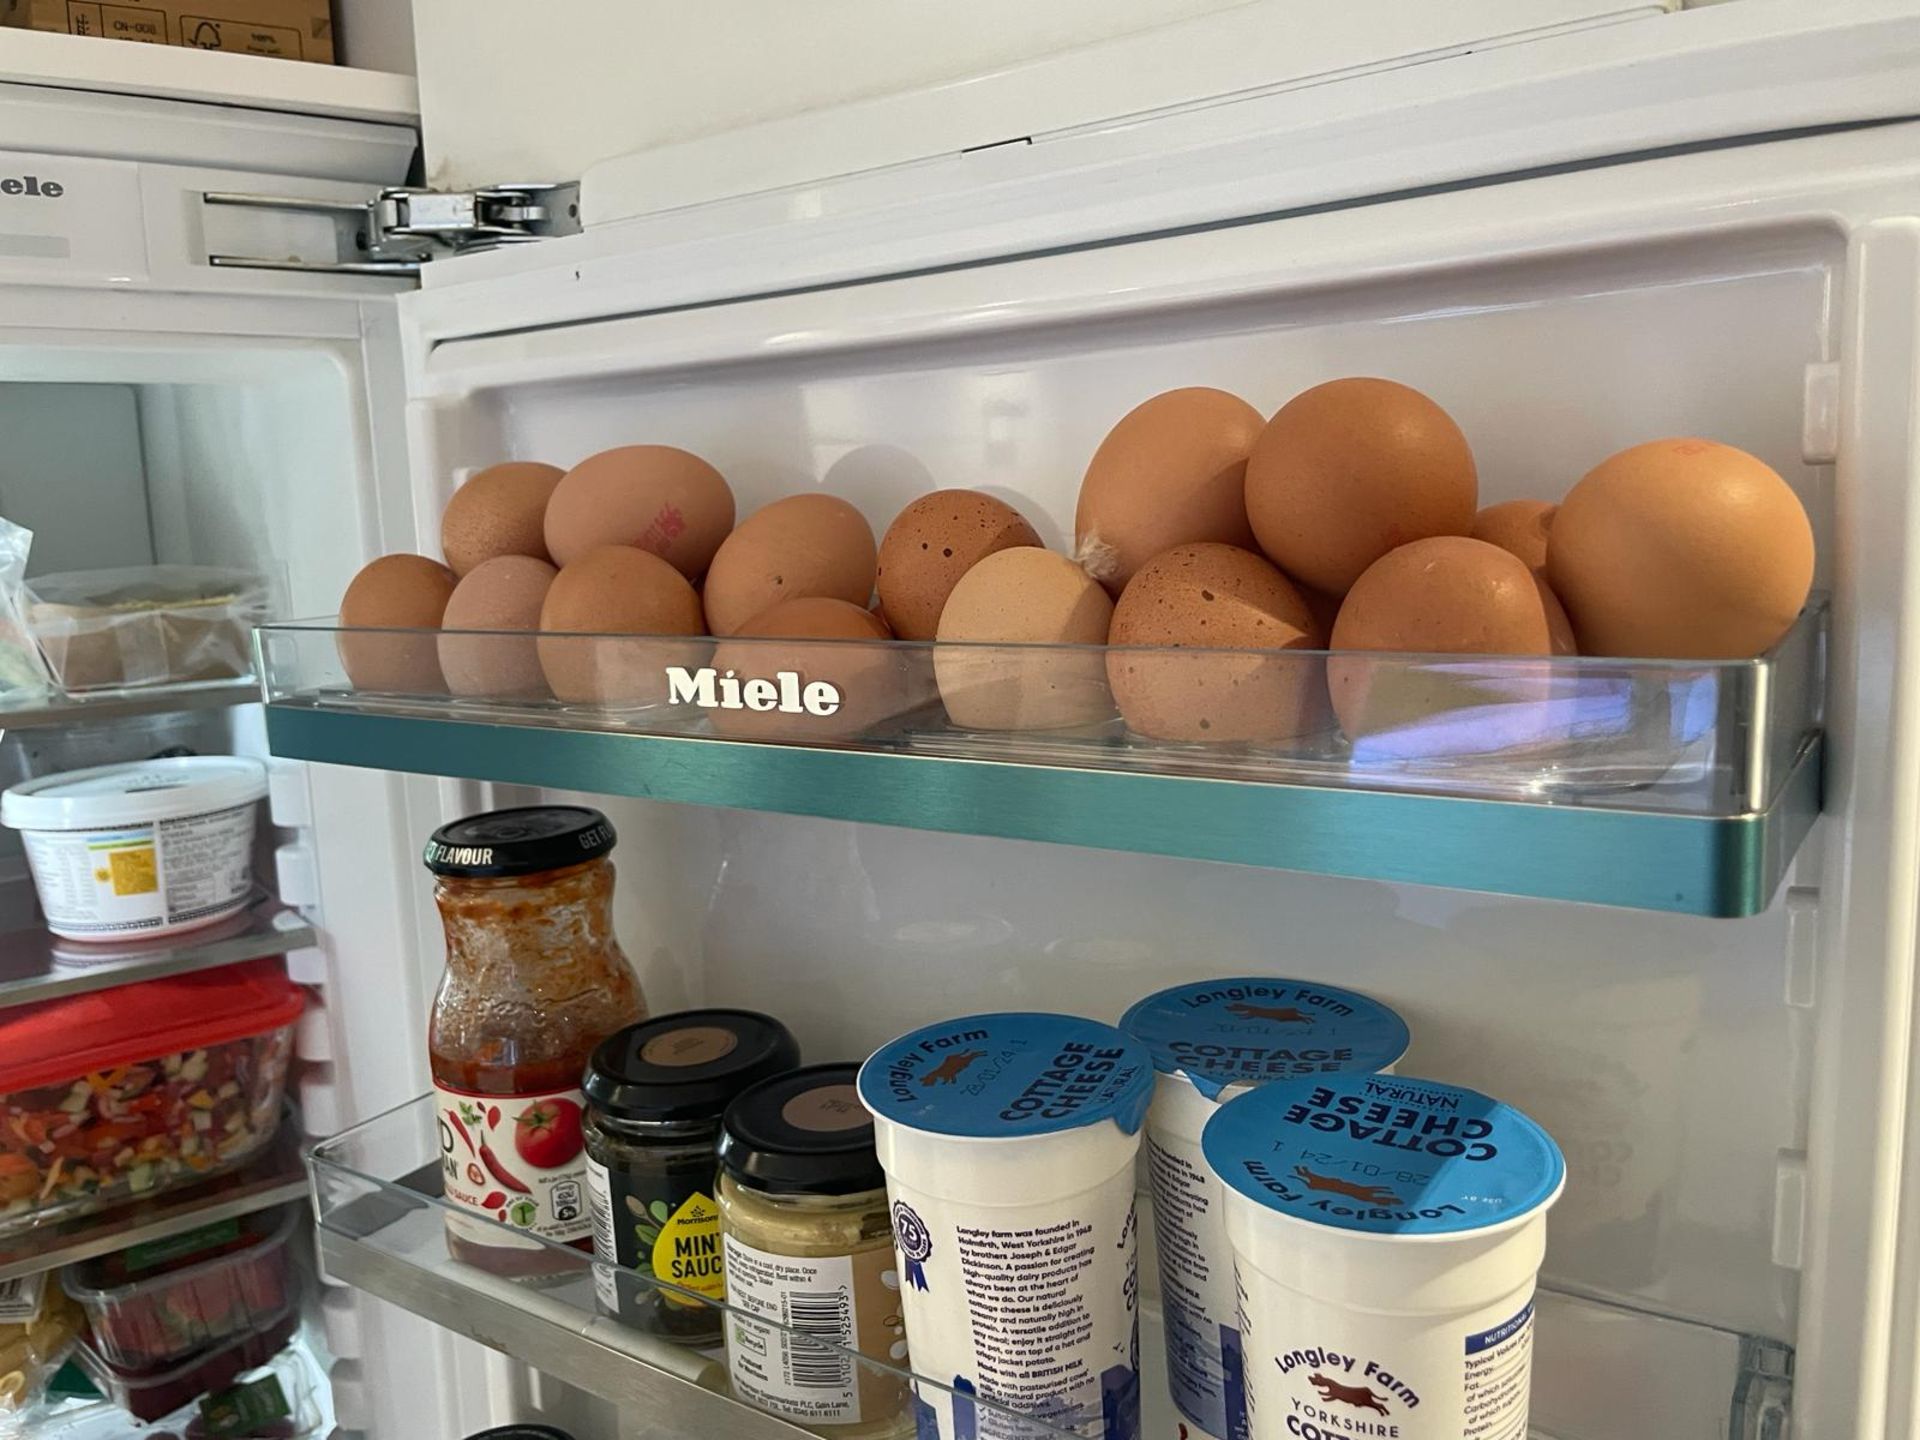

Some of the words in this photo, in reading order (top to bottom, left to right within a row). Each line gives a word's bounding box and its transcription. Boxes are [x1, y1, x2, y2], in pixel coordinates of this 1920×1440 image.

[0, 176, 64, 197] ele
[665, 667, 840, 716] Miele
[436, 845, 494, 866] FLAVOUR
[1181, 985, 1286, 1009] Longley
[1295, 989, 1354, 1017] Farm
[1168, 1041, 1353, 1062] COTTAGE
[889, 1051, 926, 1103] Longley
[919, 1028, 989, 1054] Farm
[1175, 1055, 1344, 1074] CHEESE
[999, 1042, 1095, 1122] COTTAGE
[1040, 1047, 1125, 1119] CHEESE
[1365, 1081, 1460, 1109] NATURAL
[1307, 1086, 1494, 1140] CHEESE
[1283, 1104, 1498, 1162] COTTAGE
[1299, 1149, 1431, 1186] 28/01/24
[1242, 1160, 1304, 1202] Farm
[1308, 1198, 1467, 1222] Longley
[900, 1217, 918, 1242] 75
[957, 1226, 990, 1239] Longley
[992, 1230, 1013, 1238] farm
[1035, 1222, 1071, 1236] founded
[958, 1237, 1000, 1249] Holmfirth,
[1001, 1241, 1024, 1249] West
[1026, 1236, 1065, 1248] Yorkshire
[1076, 1224, 1093, 1236] 1948
[961, 1257, 1004, 1271] Dickinson.
[1014, 1261, 1049, 1272] passion
[1050, 1258, 1062, 1266] for
[1063, 1246, 1095, 1263] creating
[972, 1250, 1008, 1260] brothers
[1010, 1250, 1043, 1260] Joseph
[1053, 1243, 1077, 1254] Edgar
[671, 1255, 723, 1279] SAUC
[802, 1266, 818, 1276] Once
[963, 1267, 1015, 1283] high-quality
[1016, 1272, 1040, 1282] dairy
[1041, 1265, 1078, 1280] products
[1078, 1259, 1092, 1269] has
[965, 1279, 992, 1291] always
[993, 1284, 1017, 1293] been
[1030, 1281, 1045, 1291] the
[1046, 1278, 1069, 1289] heart
[967, 1289, 986, 1300] what
[987, 1294, 1000, 1302] we
[1001, 1294, 1016, 1303] do.
[1017, 1295, 1034, 1303] Our
[1036, 1288, 1067, 1301] natural
[968, 1299, 999, 1313] cottage
[1000, 1305, 1031, 1313] cheese
[1041, 1294, 1083, 1311] deliciously
[840, 1295, 853, 1336] 525493
[970, 1309, 998, 1323] creamy
[1000, 1316, 1017, 1324] and
[1018, 1312, 1057, 1324] naturally
[1058, 1307, 1076, 1319] high
[971, 1319, 1000, 1334] protein.
[1010, 1325, 1047, 1336] versatile
[1048, 1316, 1082, 1332] addition
[974, 1339, 986, 1348] the
[987, 1344, 1003, 1355] pot,
[1028, 1347, 1043, 1359] top
[1062, 1340, 1075, 1349] hot
[1076, 1332, 1091, 1344] and
[975, 1349, 997, 1362] crispy
[997, 1356, 1024, 1367] jacket
[1025, 1356, 1056, 1368] potato.
[977, 1360, 998, 1374] Made
[999, 1369, 1018, 1378] with
[1018, 1370, 1031, 1379] all
[1031, 1365, 1064, 1379] BRITISH
[1065, 1358, 1084, 1372] MILK
[1464, 1351, 1495, 1370] Typical
[1274, 1346, 1356, 1375] Longley
[1363, 1360, 1421, 1410] Farm
[1464, 1367, 1494, 1381] Energy
[1464, 1382, 1480, 1392] Fat
[1466, 1392, 1476, 1403] of
[1477, 1384, 1500, 1399] which
[1290, 1396, 1400, 1438] YORKSHIRE
[1468, 1415, 1478, 1425] of
[1479, 1405, 1501, 1420] which
[1463, 1421, 1493, 1437] Protein
